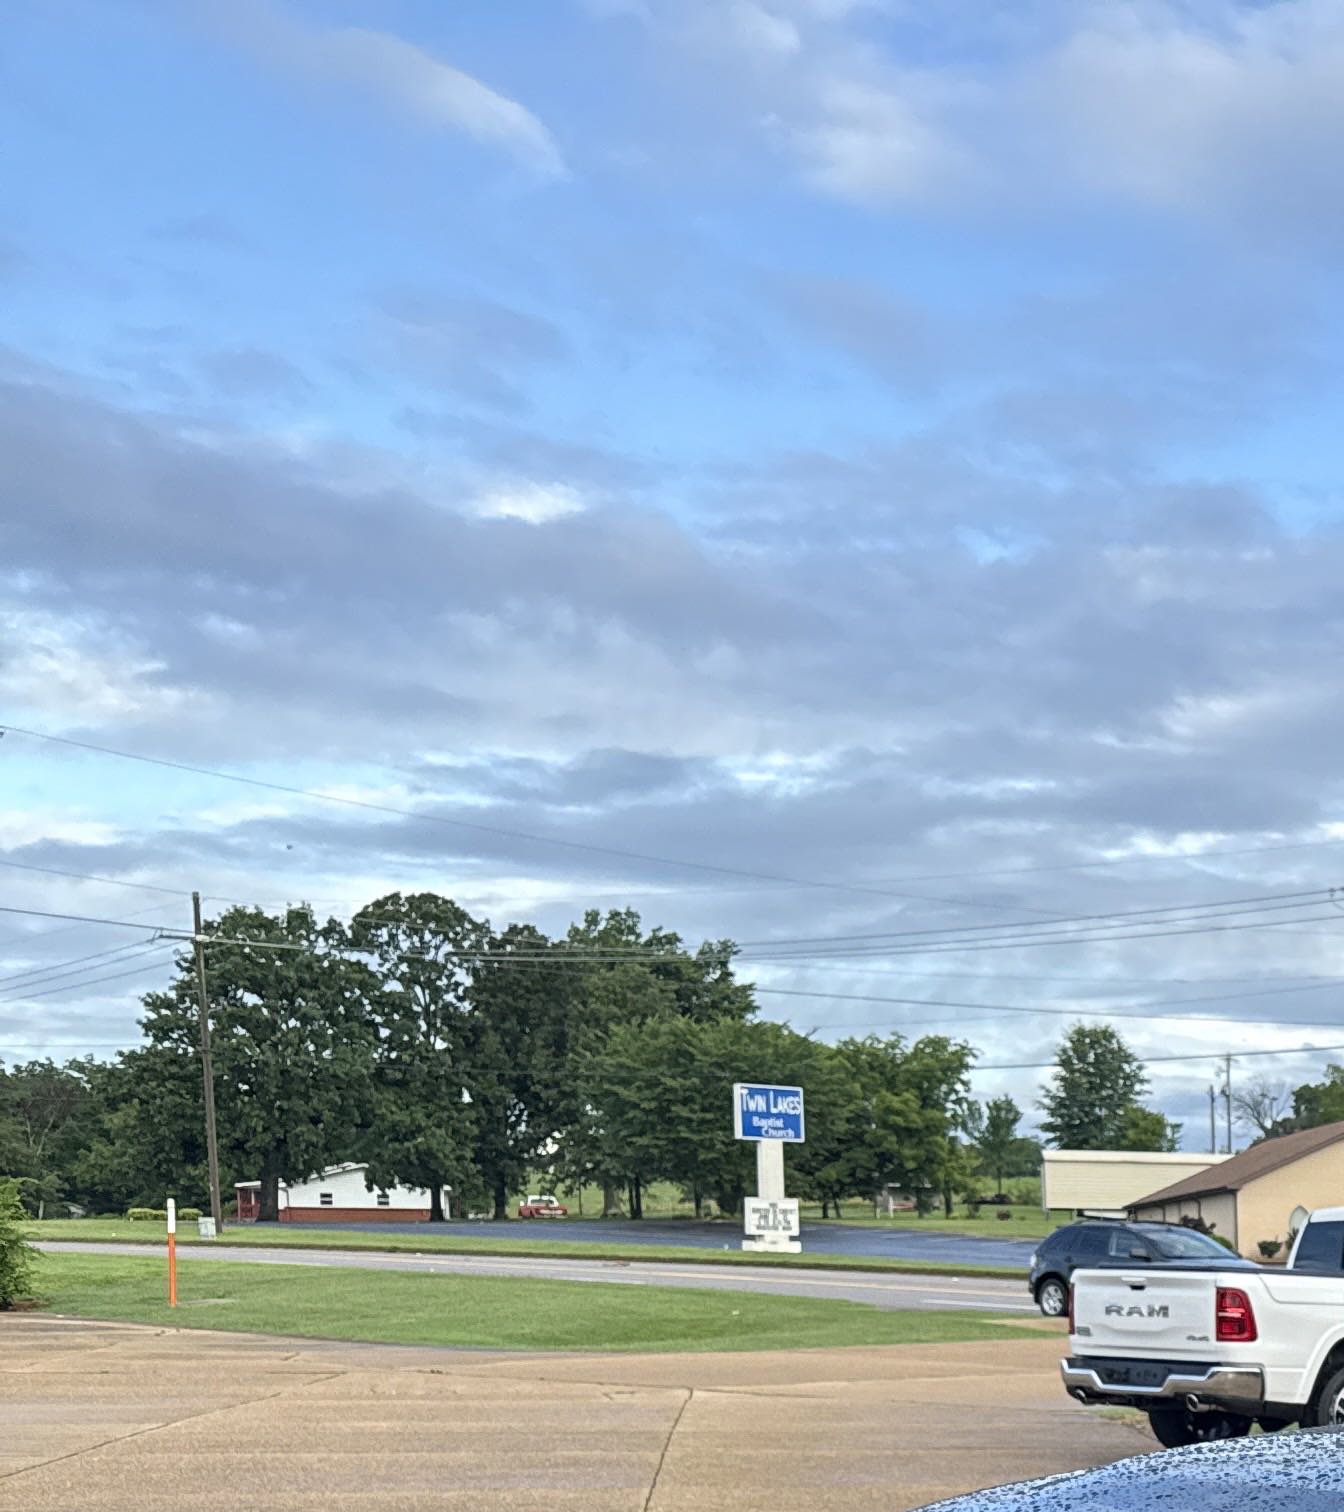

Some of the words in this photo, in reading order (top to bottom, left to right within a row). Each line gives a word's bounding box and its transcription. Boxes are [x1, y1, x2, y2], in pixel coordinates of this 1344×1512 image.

[752, 1116, 784, 1129] Baptist
[762, 1127, 795, 1138] Church
[1104, 1304, 1170, 1318] RAM
